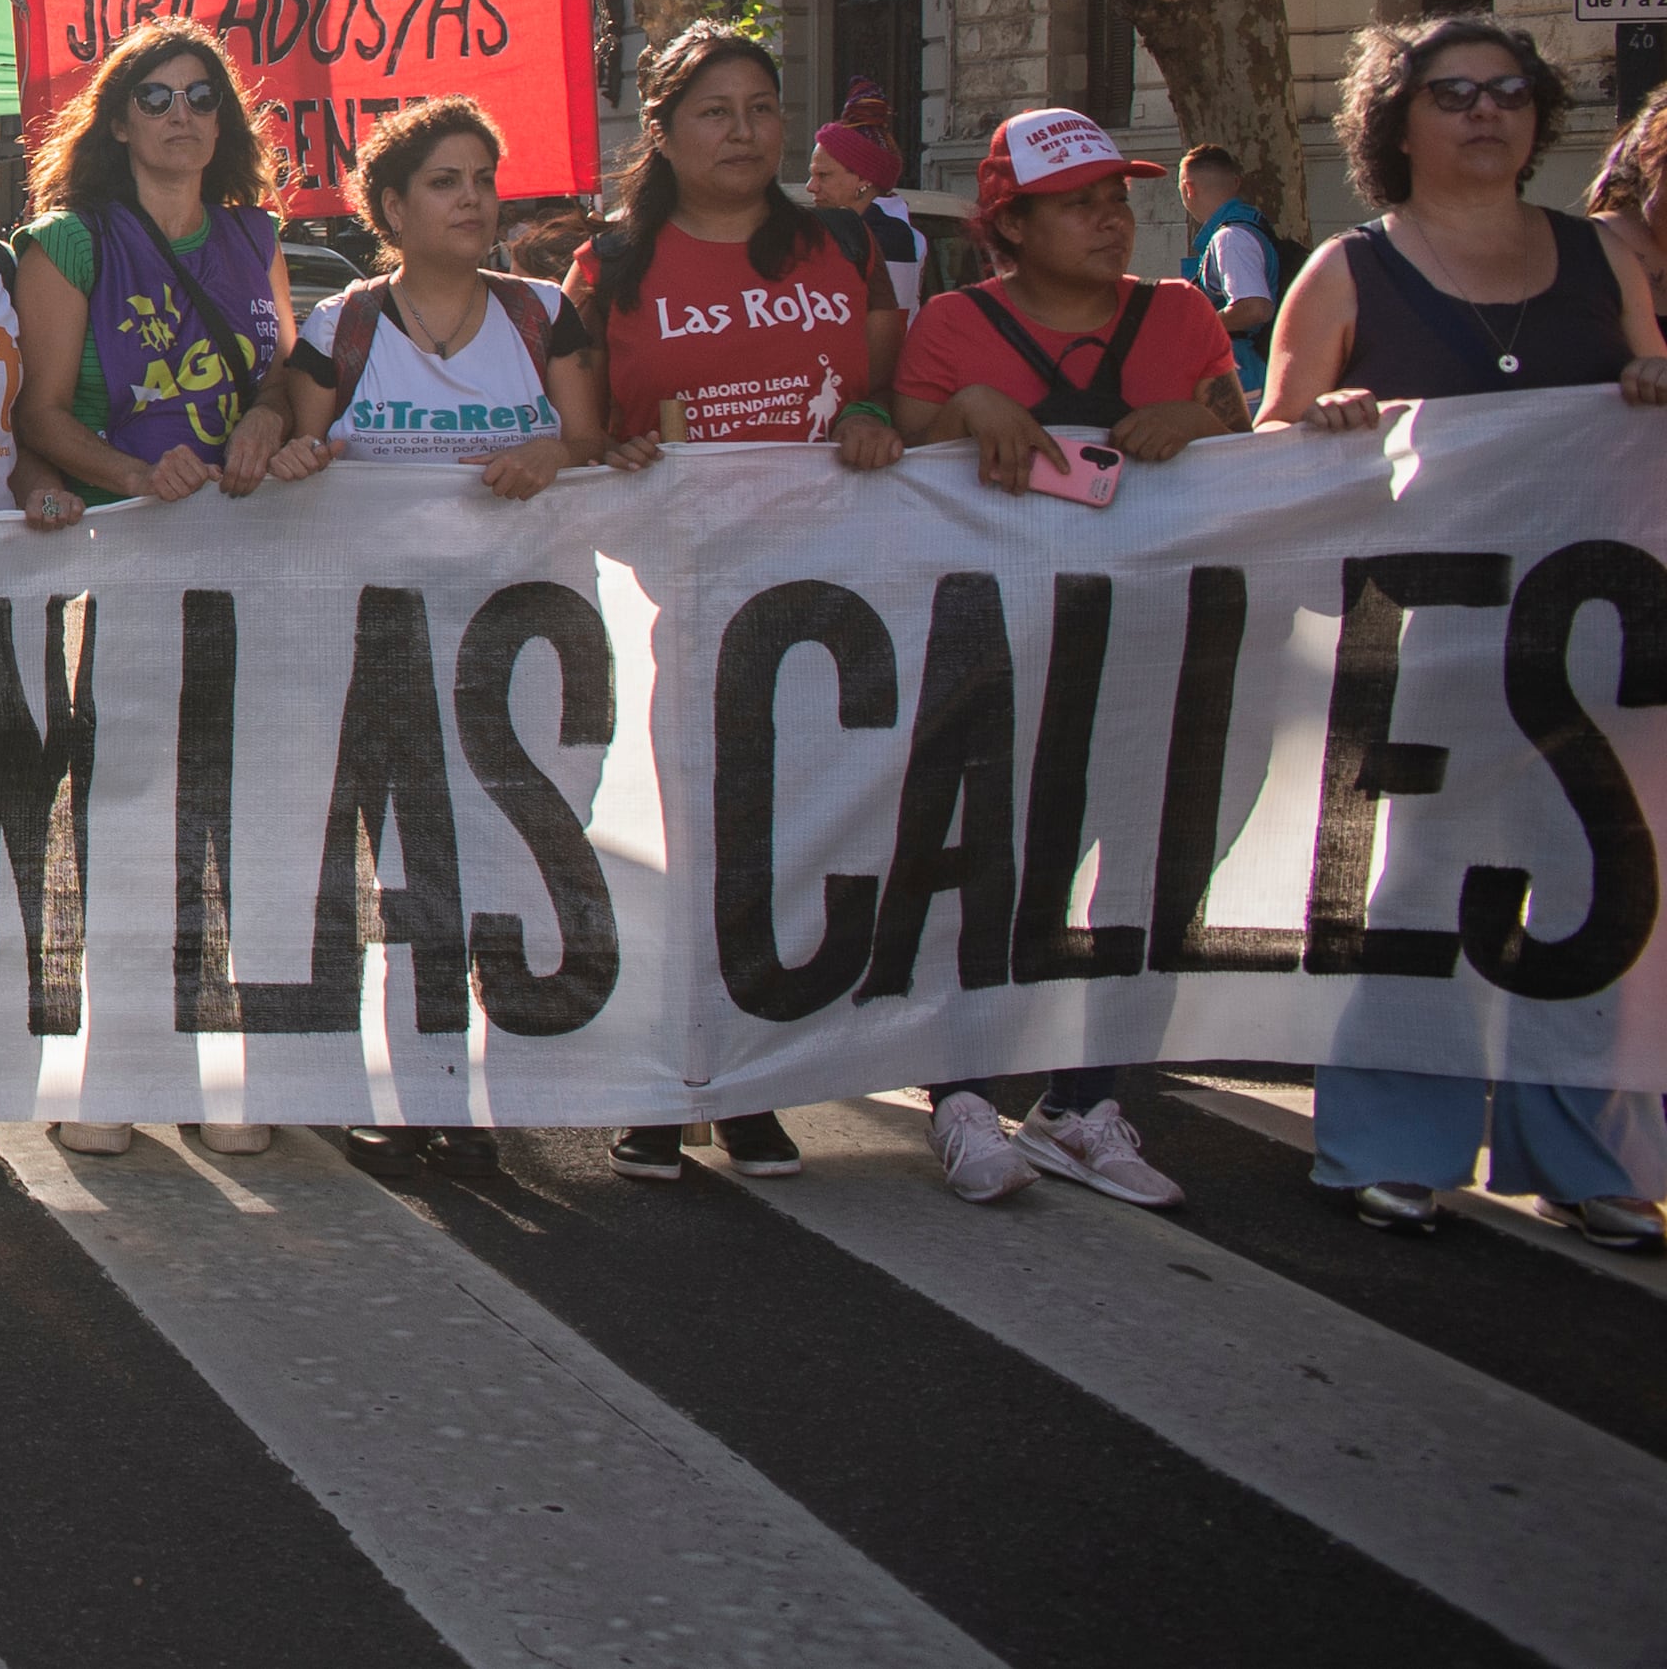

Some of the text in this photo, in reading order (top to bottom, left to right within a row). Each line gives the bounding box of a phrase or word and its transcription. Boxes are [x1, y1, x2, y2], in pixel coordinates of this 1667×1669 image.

[1628, 33, 1654, 49] 40
[1026, 128, 1049, 146] LAS
[655, 296, 733, 340] Las
[697, 381, 761, 401] ABORTO
[765, 375, 811, 392] LEGAL
[703, 392, 806, 418] DEFENDEMOS
[350, 432, 407, 445] Sindicato
[411, 434, 429, 444] de
[433, 434, 466, 445] Base
[470, 434, 488, 444] de
[372, 444, 390, 456] de
[393, 444, 449, 456] Reparto
[452, 445, 476, 455] por
[173, 581, 619, 1037] LAS
[714, 539, 1667, 1022] CALLES
